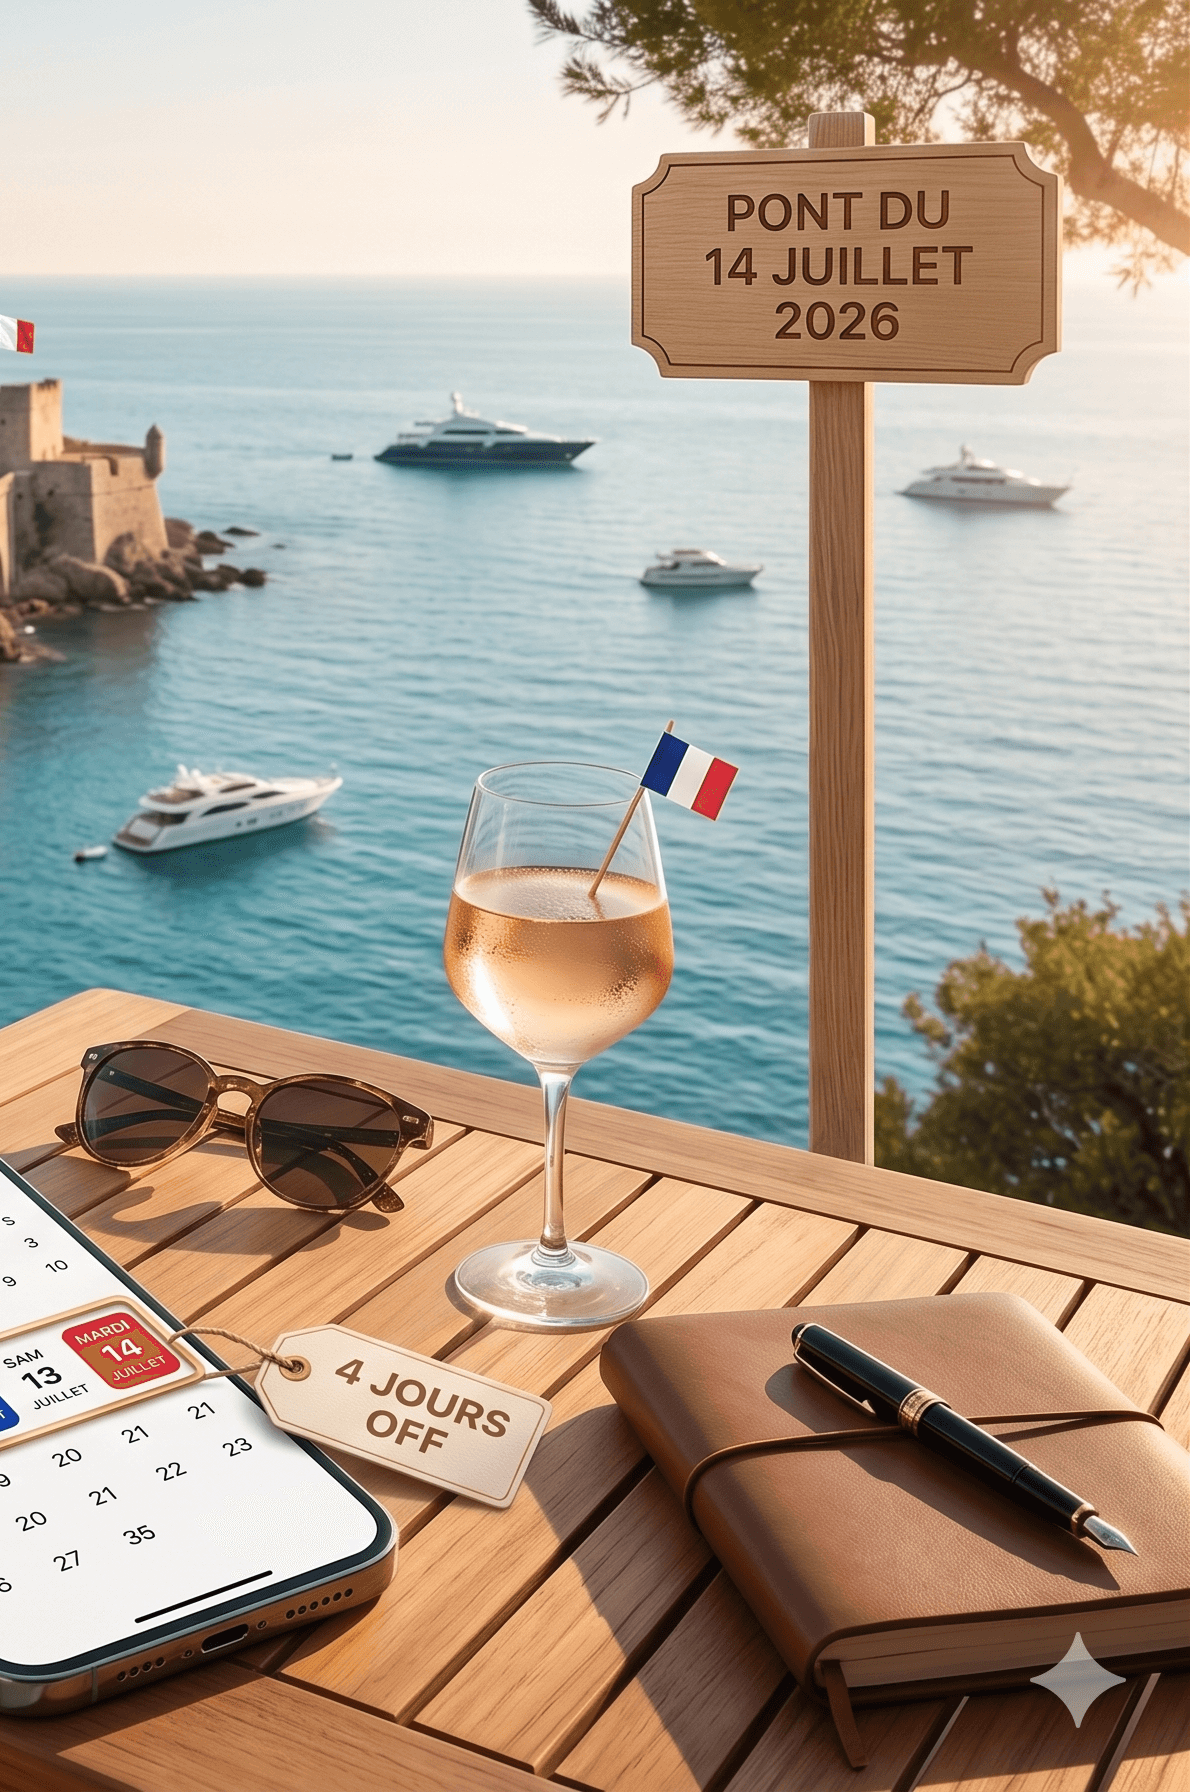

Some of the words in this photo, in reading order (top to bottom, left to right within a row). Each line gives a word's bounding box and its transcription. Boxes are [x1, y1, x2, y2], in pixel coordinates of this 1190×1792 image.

[727, 192, 863, 232] PONT
[879, 189, 950, 231] DU
[705, 246, 758, 286] 14
[771, 245, 974, 286] JUILLET
[774, 300, 900, 341] 2026
[1, 1216, 16, 1226] S
[23, 1237, 39, 1249] 3
[2, 1276, 17, 1287] 9
[45, 1259, 69, 1273] 10
[74, 1319, 131, 1345] MARDI
[3, 1349, 44, 1369] SAM
[101, 1338, 143, 1362] 14
[21, 1366, 62, 1389] 13
[113, 1355, 166, 1381] JUILLET
[33, 1383, 89, 1410] JUILLET
[334, 1358, 365, 1386] 4
[369, 1371, 511, 1438] JOURS
[51, 1448, 82, 1468] 20
[121, 1425, 149, 1444] 21
[187, 1401, 216, 1420] 21
[366, 1409, 449, 1454] OFF
[15, 1511, 47, 1532] 20
[88, 1486, 118, 1506] 21
[155, 1461, 188, 1482] 22
[222, 1437, 253, 1457] 23
[52, 1549, 80, 1572] 27
[122, 1524, 156, 1545] 35
